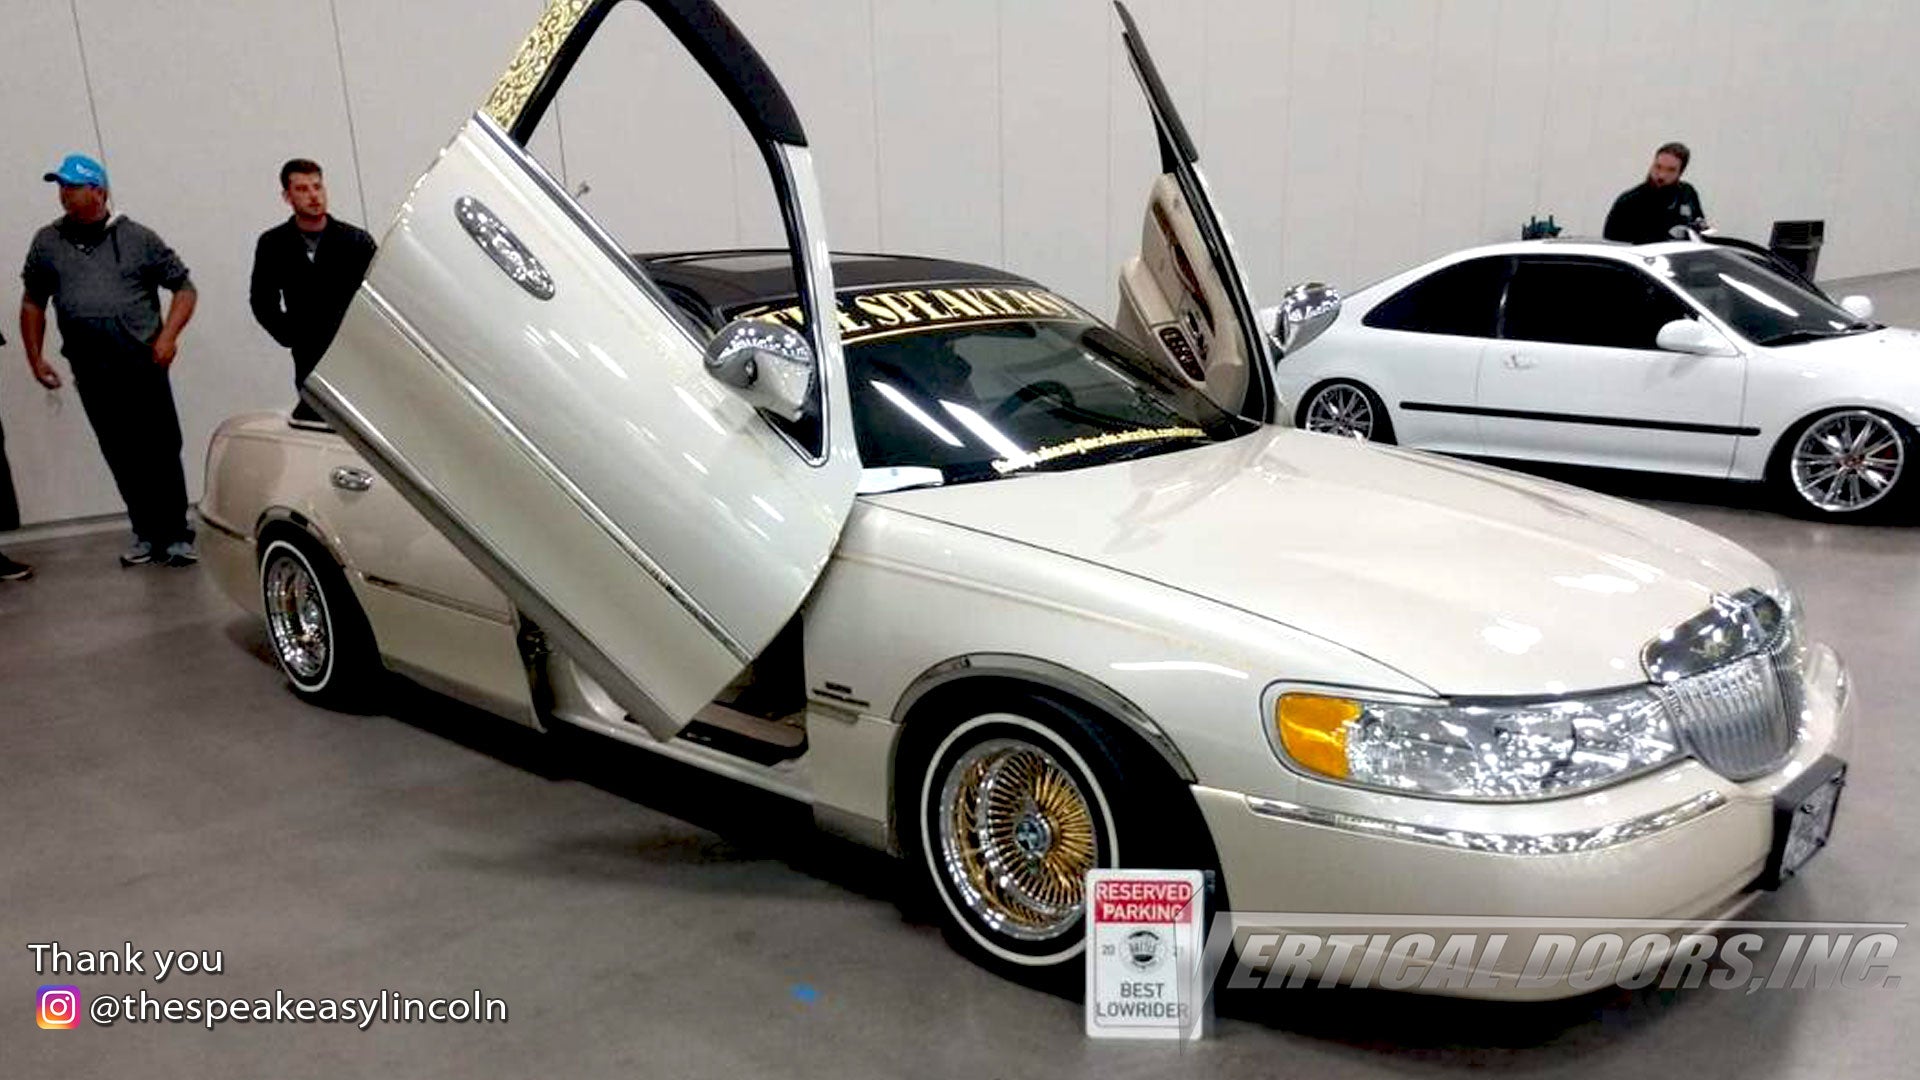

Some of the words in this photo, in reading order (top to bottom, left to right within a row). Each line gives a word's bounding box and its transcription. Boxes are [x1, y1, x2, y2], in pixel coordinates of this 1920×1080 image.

[1096, 883, 1191, 900] RESERVED
[1103, 903, 1183, 920] PARKING
[1120, 983, 1165, 998] BEST
[1096, 1002, 1189, 1018] LOWRIDER
